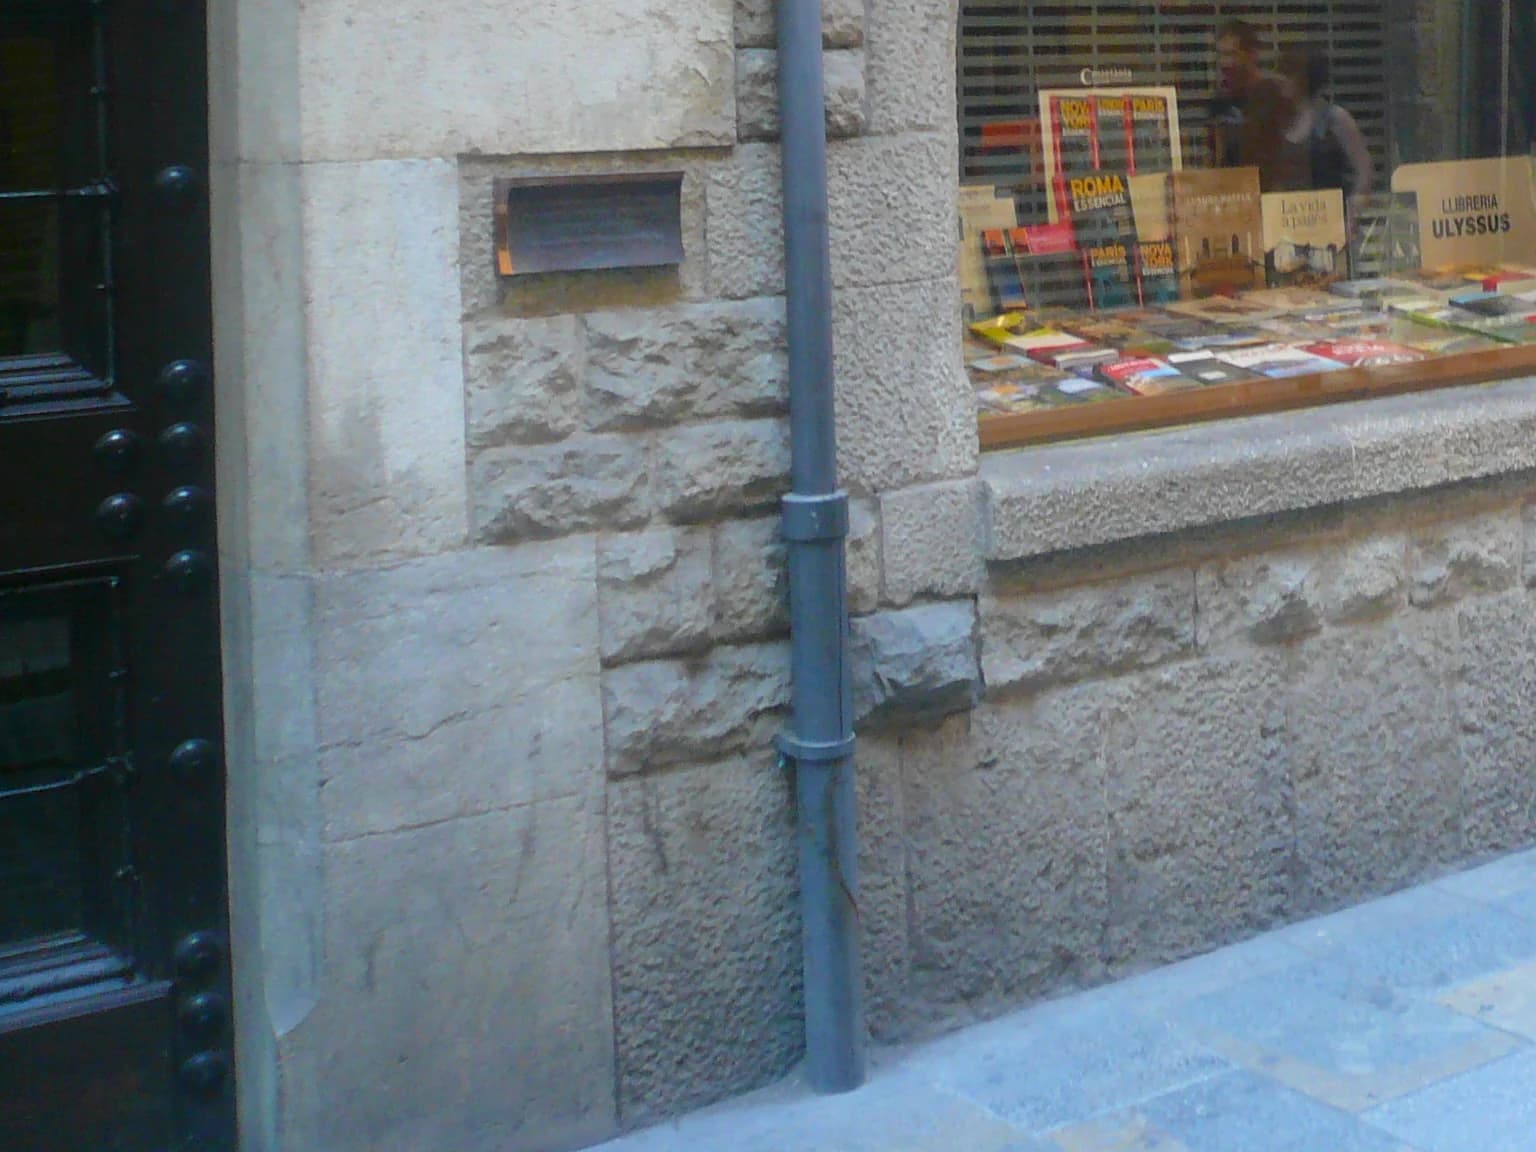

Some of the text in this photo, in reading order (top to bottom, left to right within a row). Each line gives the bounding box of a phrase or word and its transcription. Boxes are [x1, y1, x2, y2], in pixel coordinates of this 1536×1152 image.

[1070, 175, 1124, 198] ROMA
[1441, 193, 1499, 213] LLIBRERIA
[1432, 213, 1512, 240] ULYSSUS
